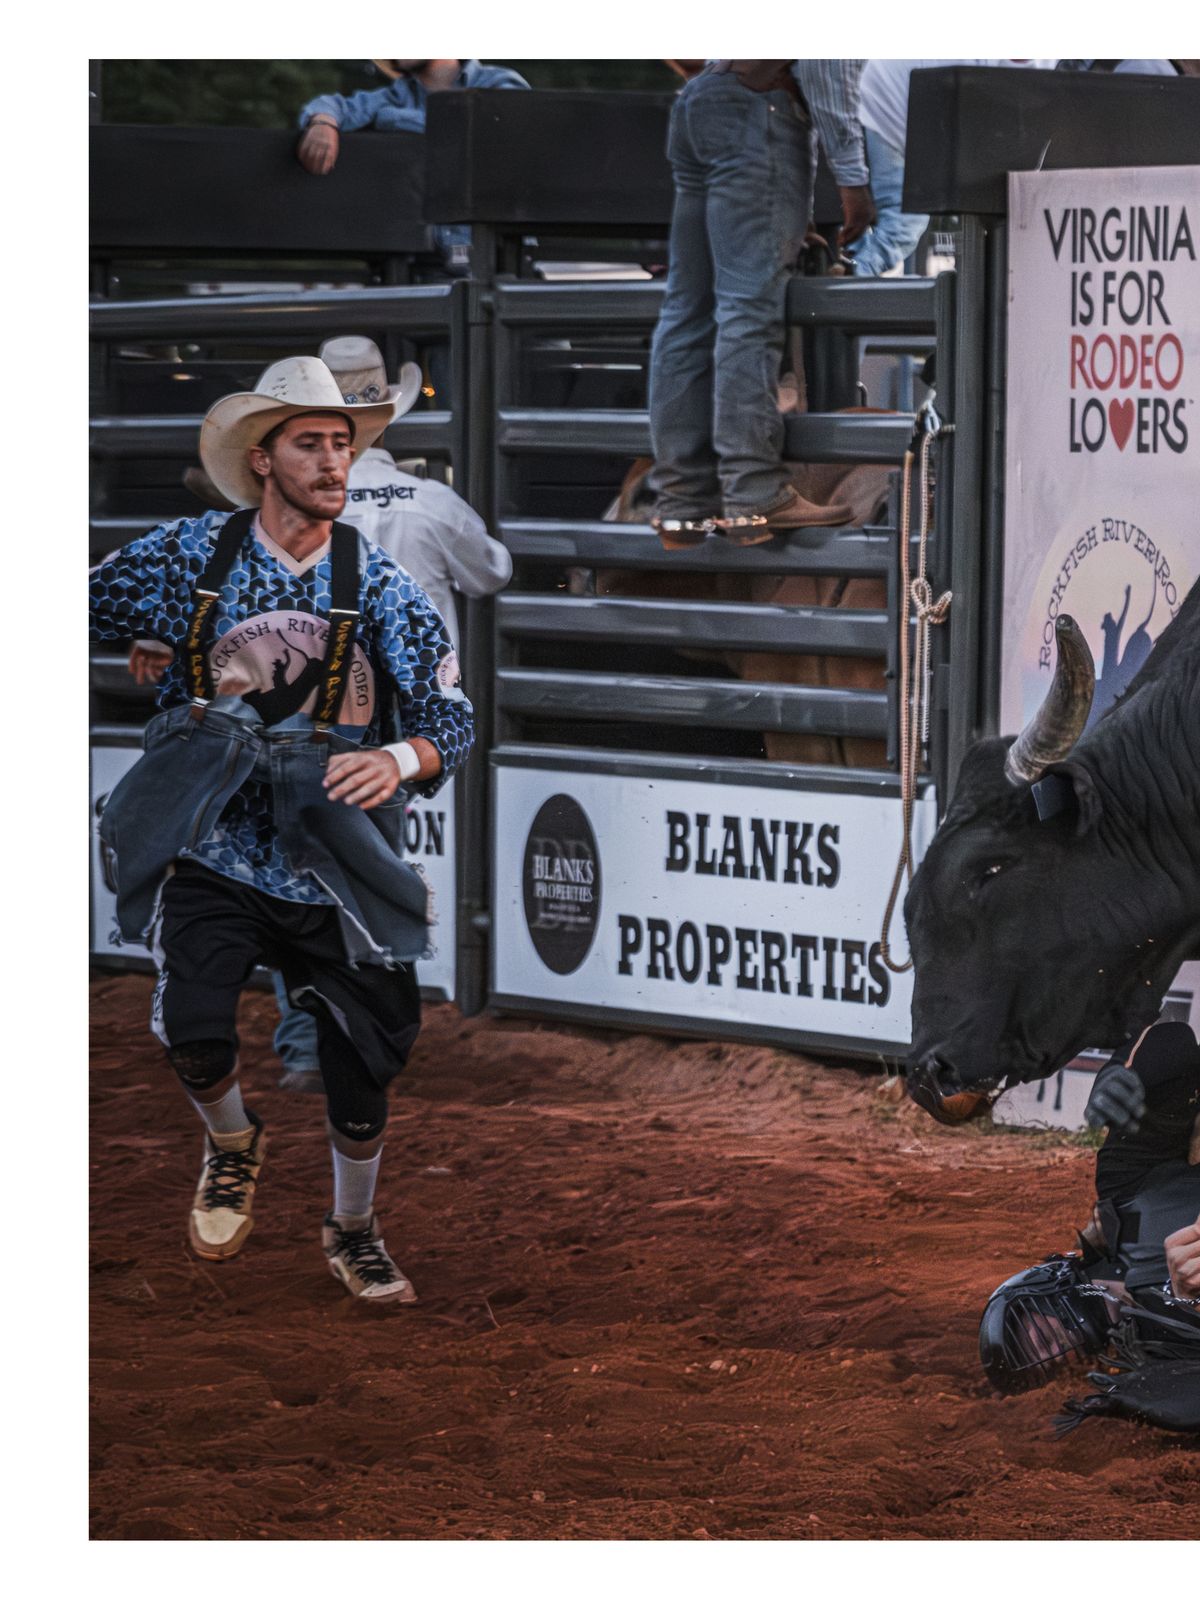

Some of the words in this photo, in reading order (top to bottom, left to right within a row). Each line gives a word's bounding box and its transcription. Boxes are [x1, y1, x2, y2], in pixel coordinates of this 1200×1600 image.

[1044, 205, 1196, 263] VIRGINIA
[1071, 271, 1094, 327] IS
[1102, 270, 1171, 326] FOR
[1070, 333, 1184, 391] RODEO
[345, 484, 416, 508] rangler
[1039, 526, 1098, 671] ROCKFISH
[1102, 517, 1156, 564] RIVER
[212, 621, 271, 687] OCKFISH
[288, 617, 331, 643] RIVE
[351, 660, 370, 707] ODEO
[532, 854, 595, 885] BLANKS
[666, 811, 840, 889] BLANKS
[617, 914, 891, 1008] PROPERTIES
